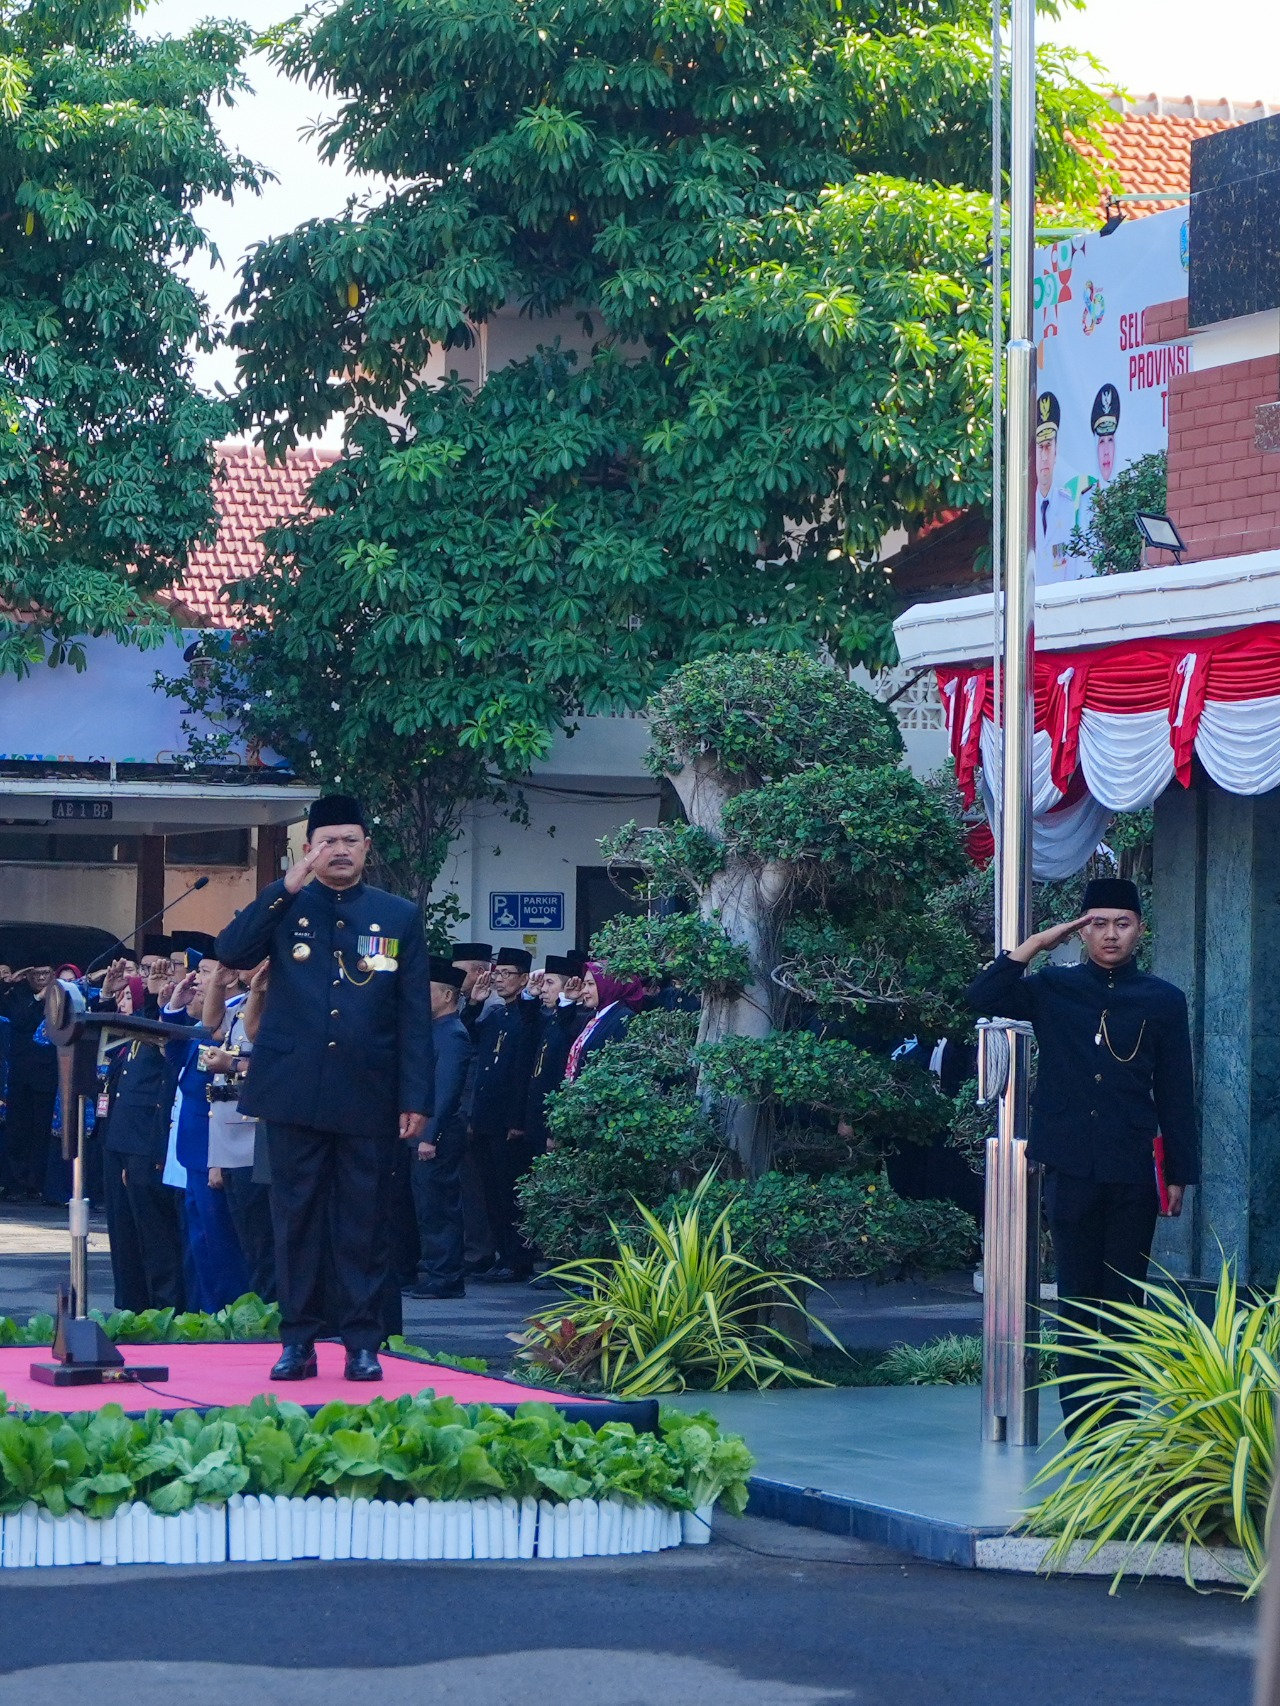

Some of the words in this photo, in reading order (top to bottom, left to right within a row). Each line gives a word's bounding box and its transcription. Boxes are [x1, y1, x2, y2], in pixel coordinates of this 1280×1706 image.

[1129, 345, 1190, 392] PROVINSI
[56, 802, 74, 818] AE
[80, 803, 87, 818] 1
[93, 803, 109, 818] BP
[494, 895, 508, 914] P
[523, 896, 558, 905] PARKIR
[523, 906, 557, 915] MOTOR
